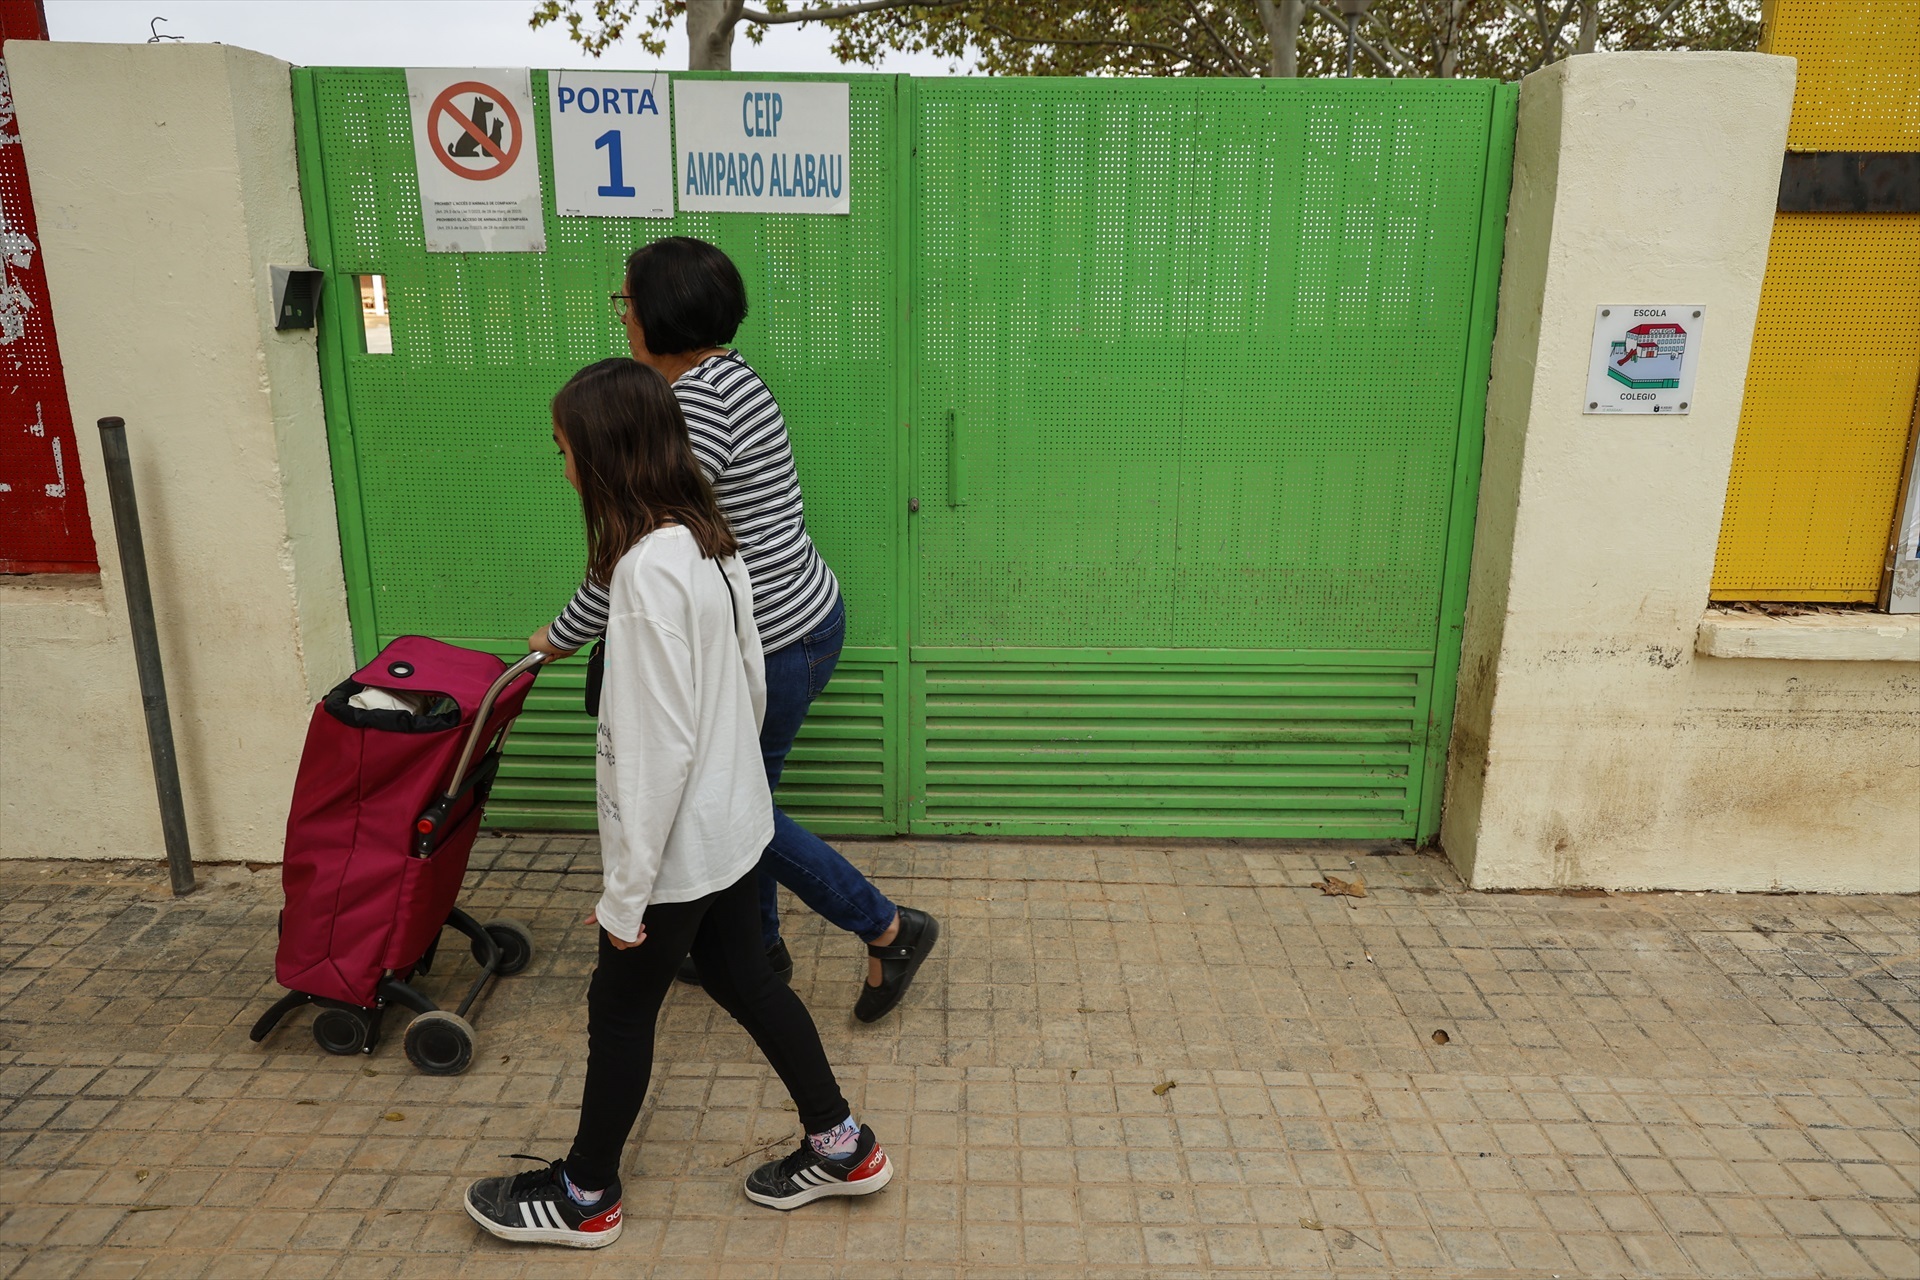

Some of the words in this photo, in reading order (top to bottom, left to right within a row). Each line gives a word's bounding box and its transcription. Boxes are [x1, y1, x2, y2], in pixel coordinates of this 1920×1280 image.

[558, 87, 659, 115] PORTA
[742, 91, 783, 138] CEIP
[595, 129, 636, 198] 1
[686, 151, 764, 197] AMPARO
[769, 153, 842, 199] ALABAU
[1633, 309, 1667, 317] ESCOLA
[1620, 393, 1657, 401] COLEGIO
